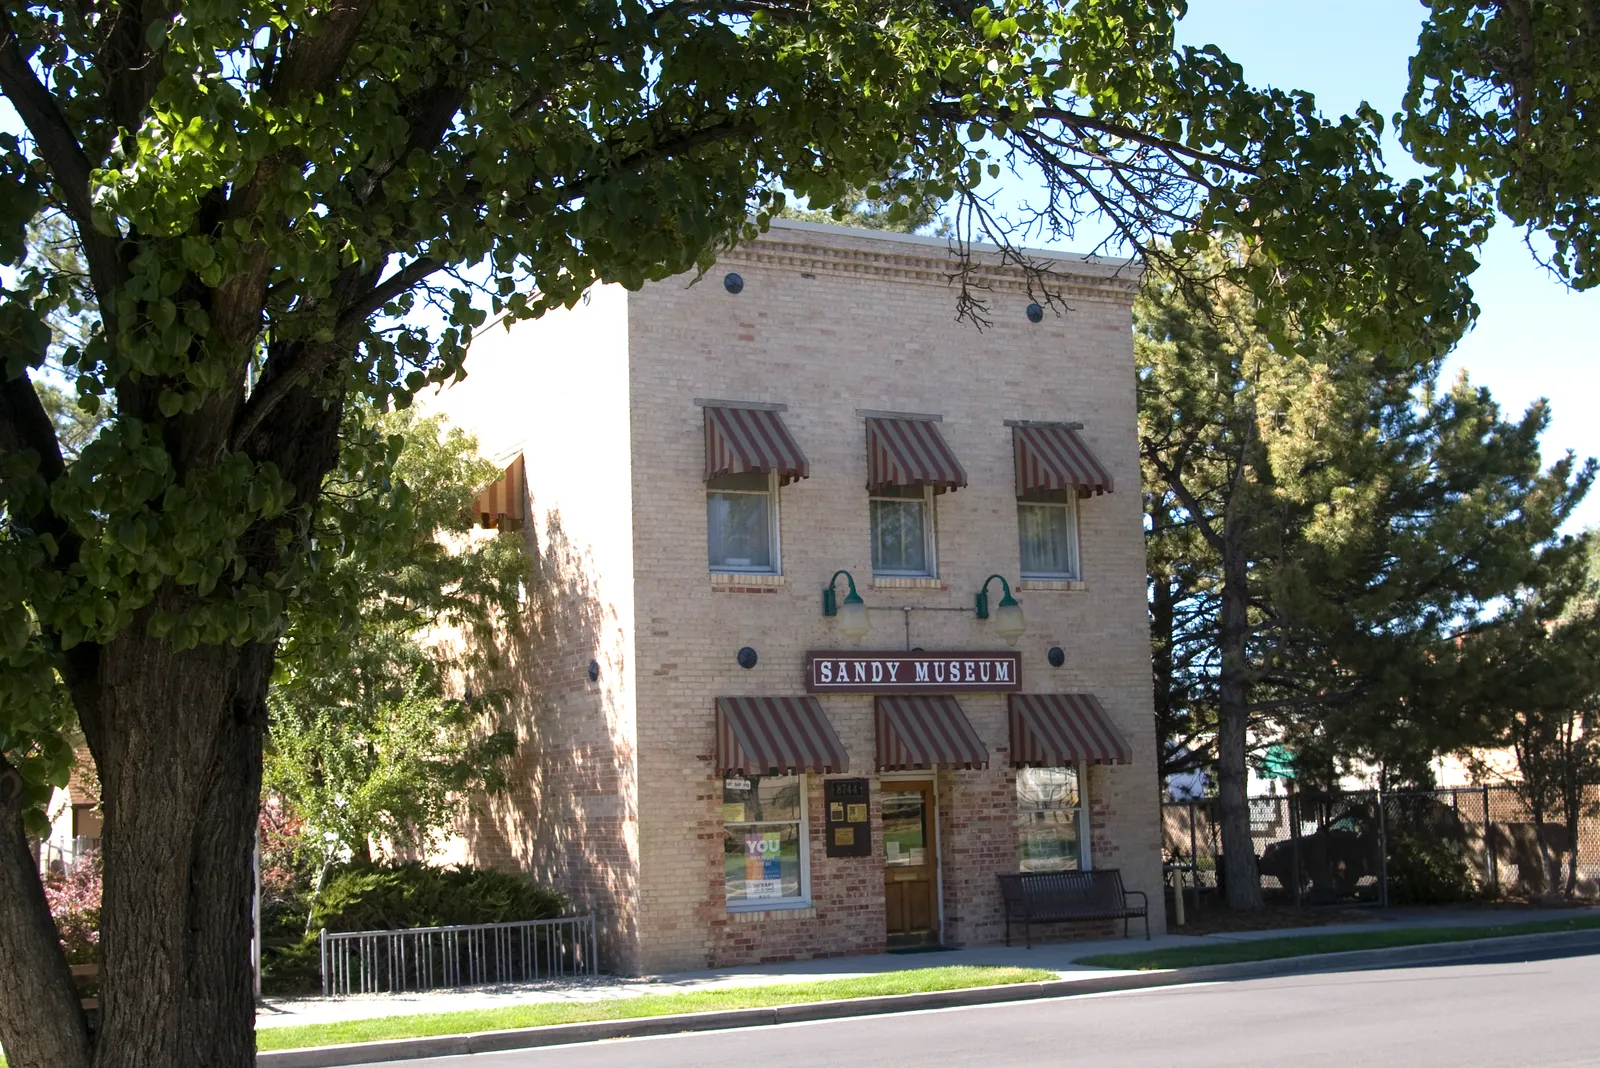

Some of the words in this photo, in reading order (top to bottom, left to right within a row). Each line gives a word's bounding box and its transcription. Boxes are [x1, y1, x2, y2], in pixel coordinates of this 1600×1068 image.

[820, 661, 900, 683] SANDY
[914, 661, 1009, 682] MUSEUM
[836, 783, 858, 795] 8744
[746, 840, 780, 853] YOU
